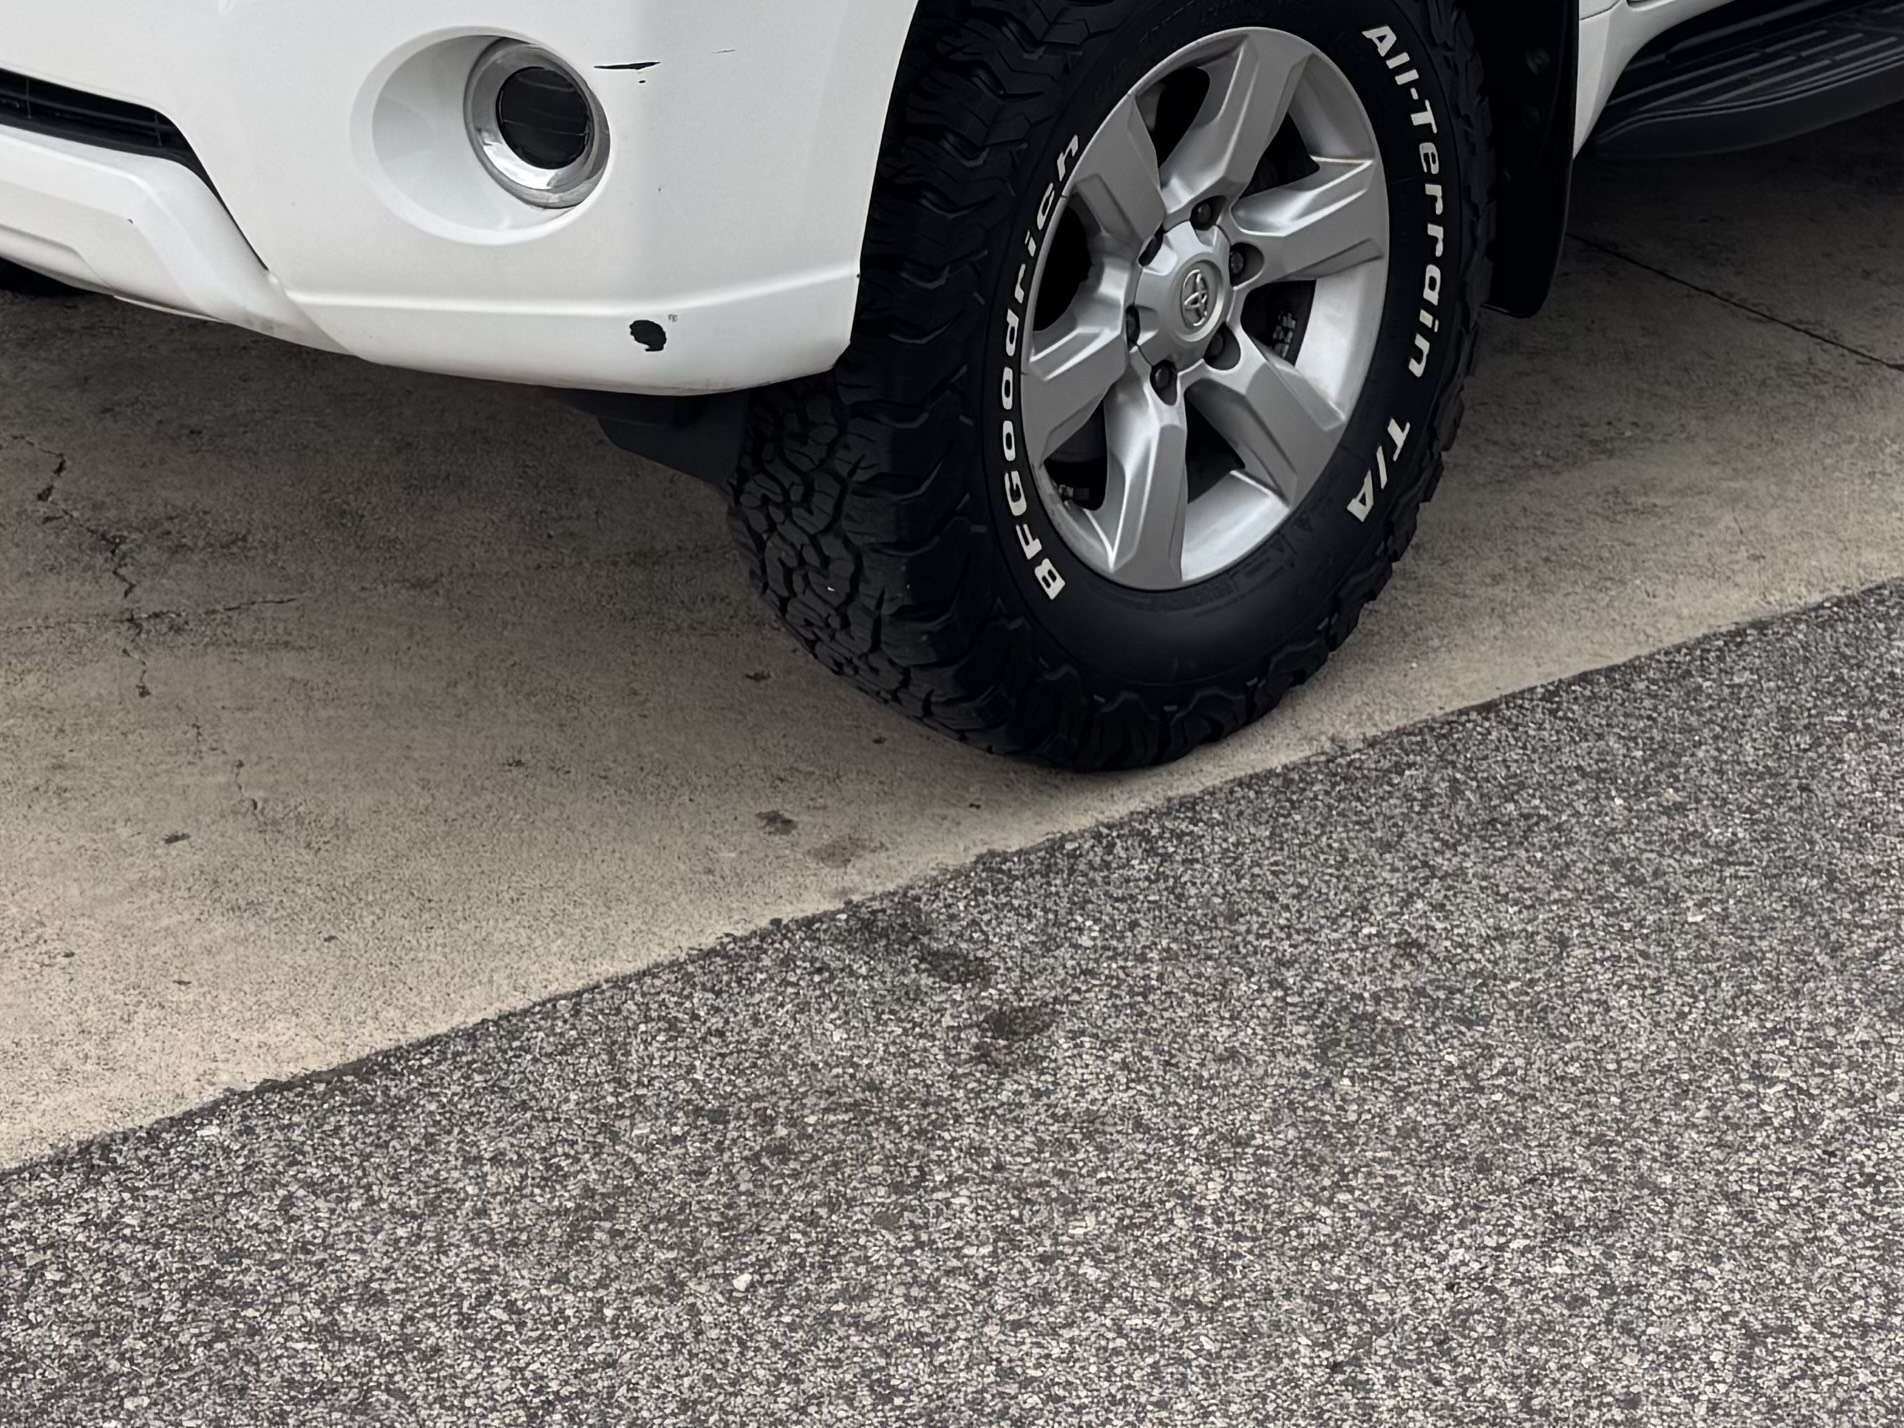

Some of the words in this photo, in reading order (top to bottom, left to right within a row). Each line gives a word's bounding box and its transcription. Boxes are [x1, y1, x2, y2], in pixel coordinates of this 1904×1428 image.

[1001, 134, 1079, 600] BFGoodrich
[1361, 25, 1445, 378] All-Terrain
[1346, 417, 1410, 523] T/A
